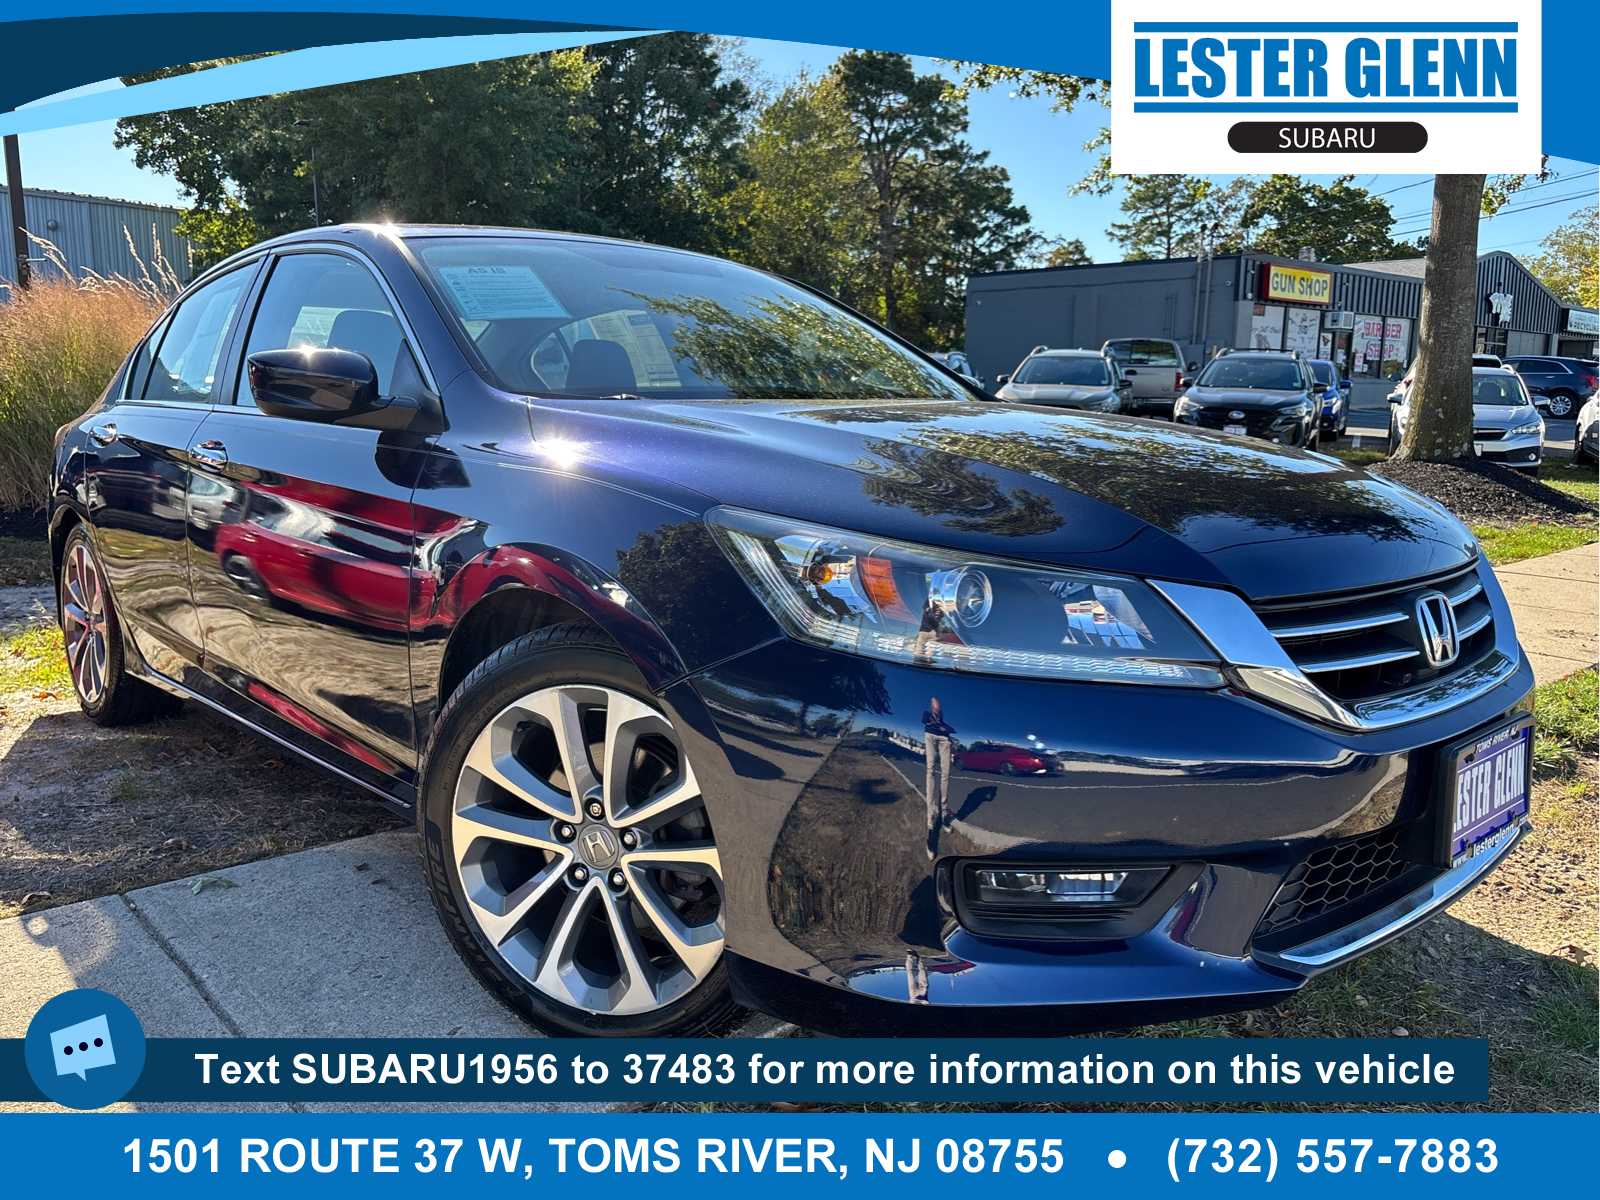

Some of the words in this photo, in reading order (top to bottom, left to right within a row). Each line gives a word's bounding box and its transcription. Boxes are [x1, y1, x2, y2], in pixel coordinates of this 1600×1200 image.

[1271, 272, 1296, 294] GUN
[1299, 276, 1329, 298] SHOP
[1453, 760, 1492, 833] ESTER
[1494, 742, 1525, 809] GLENN
